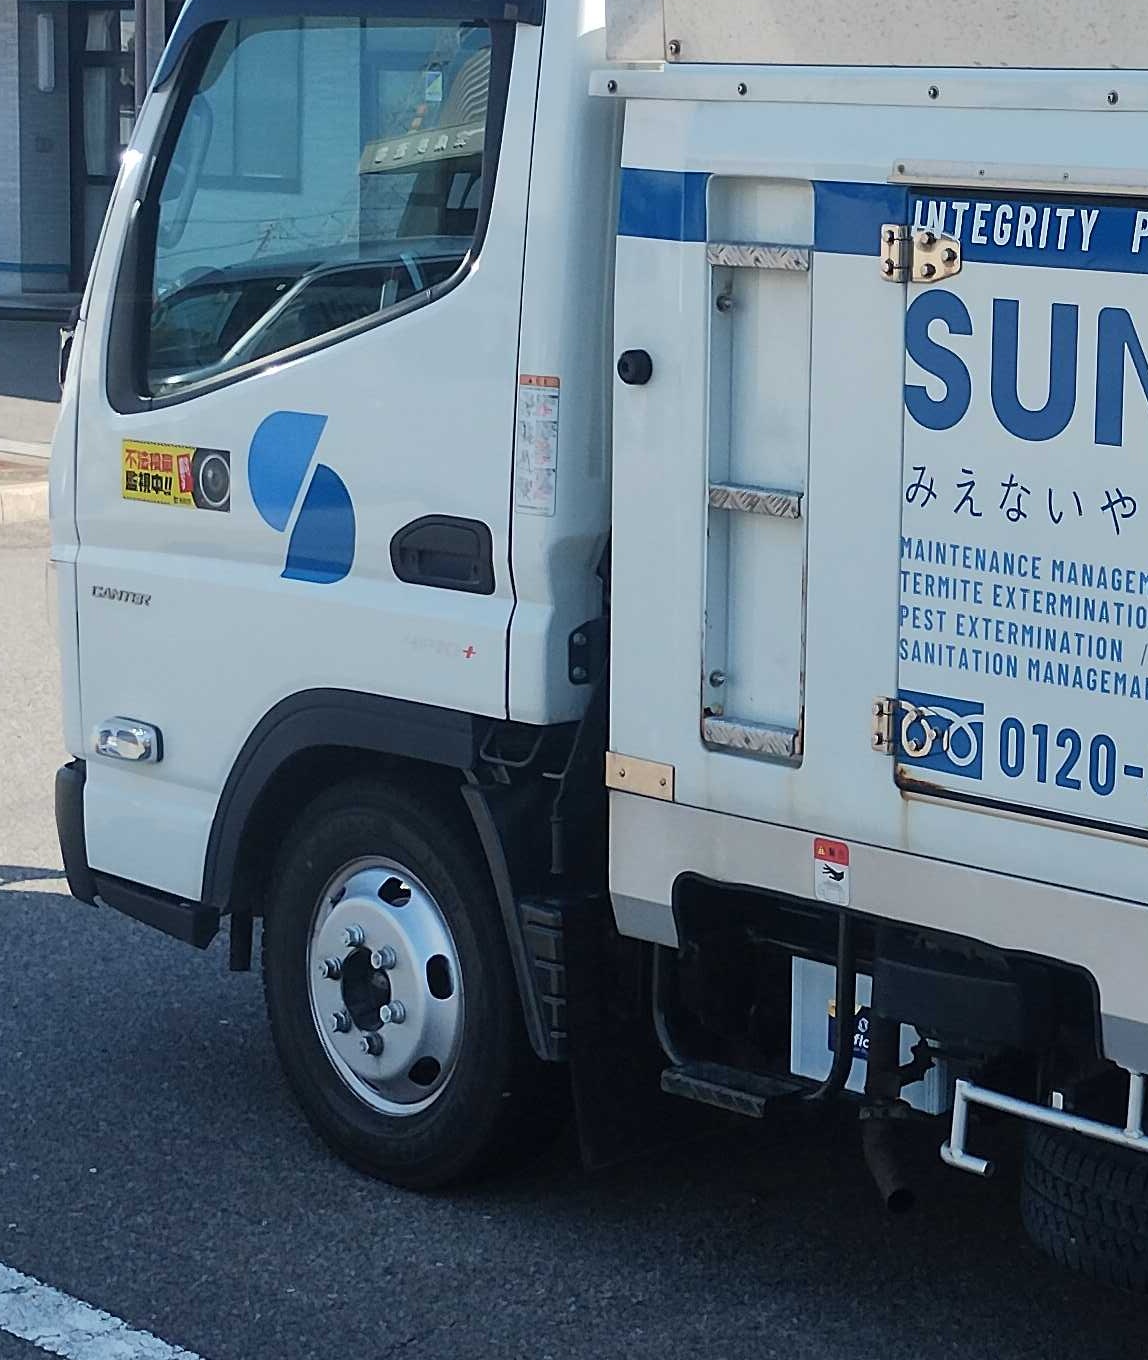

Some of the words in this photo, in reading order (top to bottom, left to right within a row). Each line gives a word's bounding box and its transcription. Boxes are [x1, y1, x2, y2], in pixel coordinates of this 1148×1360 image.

[912, 199, 1099, 252] INTEGRITY
[901, 536, 1042, 580] MAINTENANCE
[901, 570, 984, 605] TERMITE
[900, 604, 947, 632] PEST
[956, 612, 1123, 662] EXTERMINATION
[900, 638, 1018, 679] SANITATION
